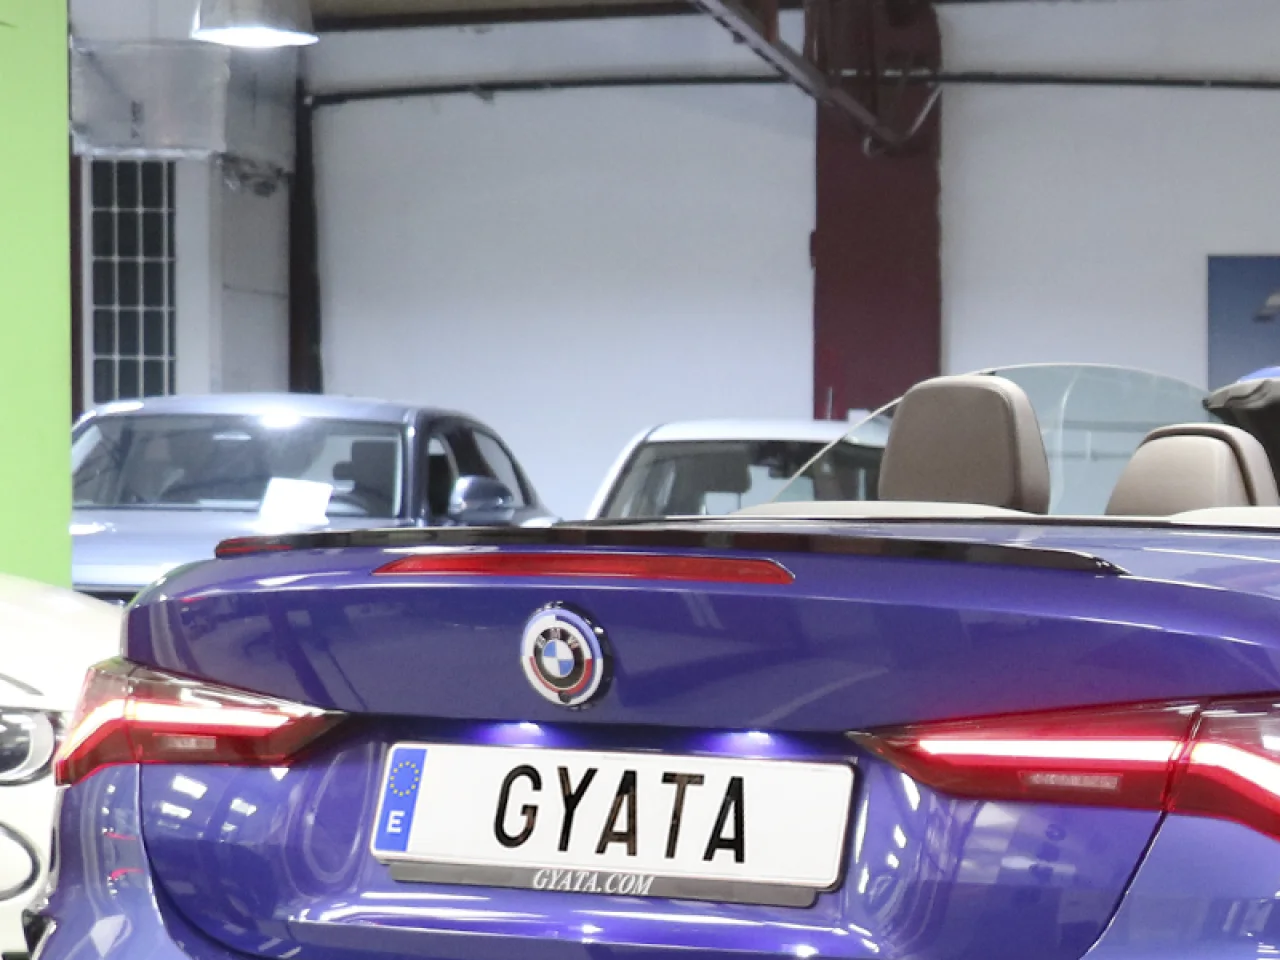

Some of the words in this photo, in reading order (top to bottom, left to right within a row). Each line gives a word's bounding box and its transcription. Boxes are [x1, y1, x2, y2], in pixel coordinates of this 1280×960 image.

[385, 809, 405, 834] E
[492, 764, 746, 864] GYATA
[533, 868, 655, 895] GYATA.COM
